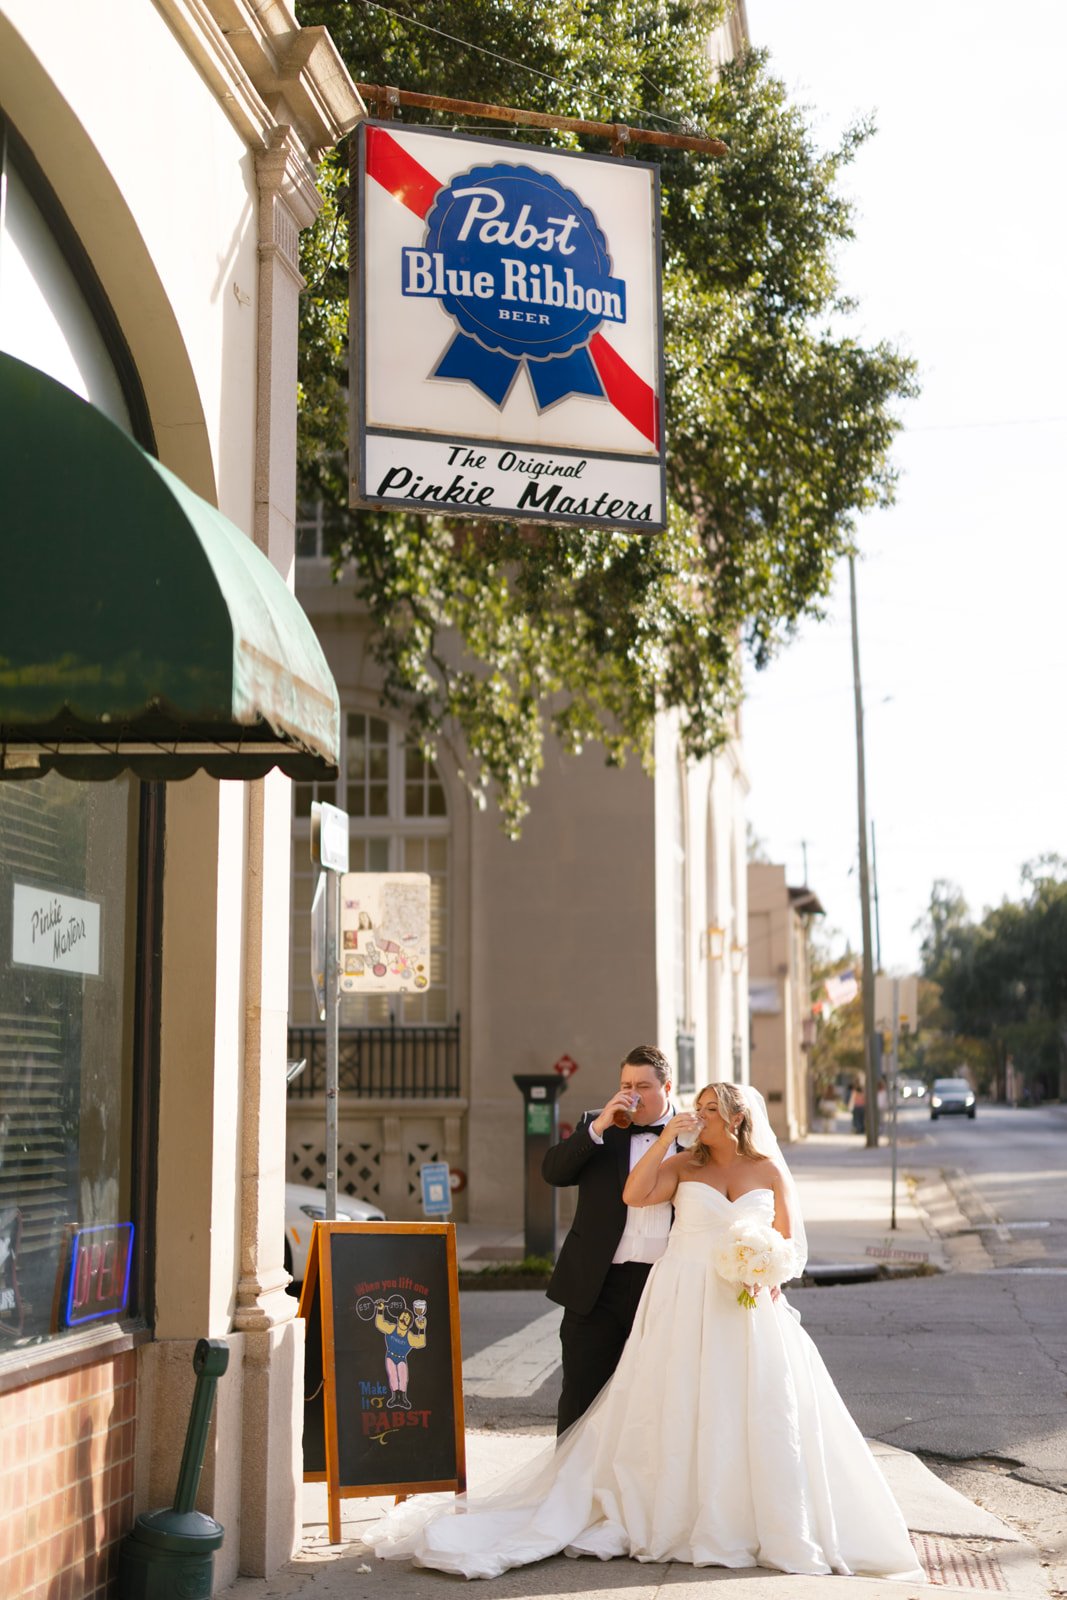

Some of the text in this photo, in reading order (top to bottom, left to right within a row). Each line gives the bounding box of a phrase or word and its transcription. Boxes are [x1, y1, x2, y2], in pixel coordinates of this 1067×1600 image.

[452, 187, 580, 255] Pabst
[405, 251, 624, 319] Blue Ribbon
[498, 309, 551, 325] BEER
[447, 446, 587, 479] The Original
[376, 466, 653, 522] Pinkie Masters
[31, 898, 63, 944] Pinkie
[53, 917, 87, 963] Masters
[73, 1240, 128, 1308] OPEN
[355, 1276, 430, 1297] When you lift one
[359, 1302, 371, 1312] EST
[359, 1381, 388, 1395] Make
[361, 1410, 432, 1436] PABST
